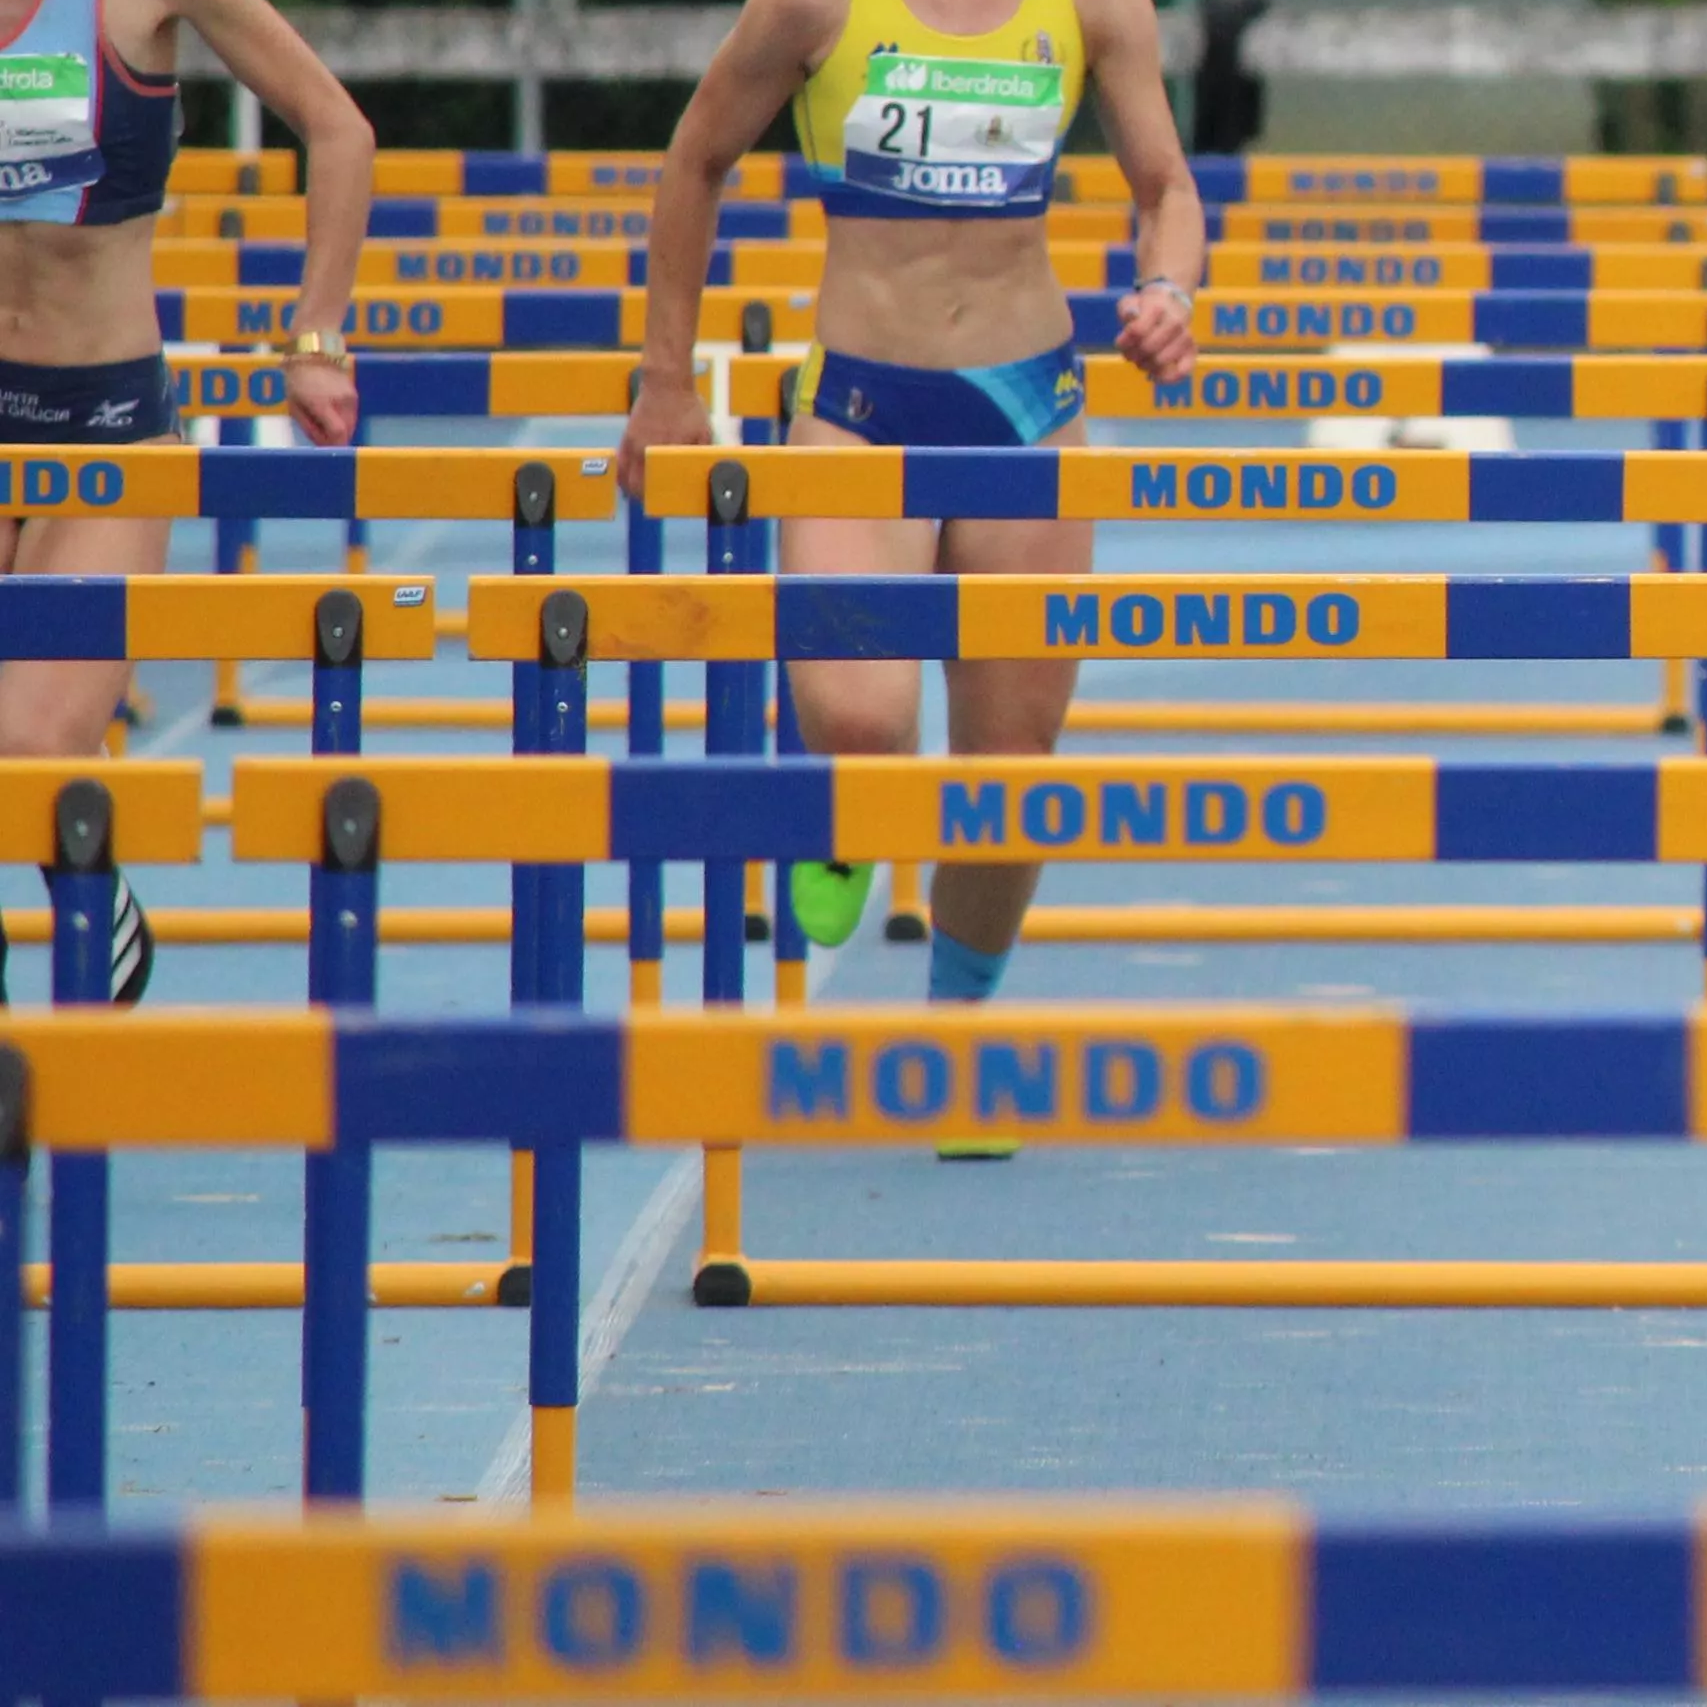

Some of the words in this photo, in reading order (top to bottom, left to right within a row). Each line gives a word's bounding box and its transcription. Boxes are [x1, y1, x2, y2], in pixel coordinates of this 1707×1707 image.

[931, 69, 1035, 97] Iberdrola
[878, 101, 932, 158] 21
[893, 162, 1009, 194] Joma
[396, 251, 580, 281] MONDO
[1260, 256, 1441, 284] MONDO
[1213, 303, 1416, 337] MONDO
[1154, 369, 1383, 410] MONDO
[1131, 463, 1397, 509] MONDO
[1044, 592, 1360, 646] MONDO
[939, 780, 1327, 847] MONDO
[764, 1038, 1267, 1123] MONDO
[384, 1554, 1096, 1670] MONDO
